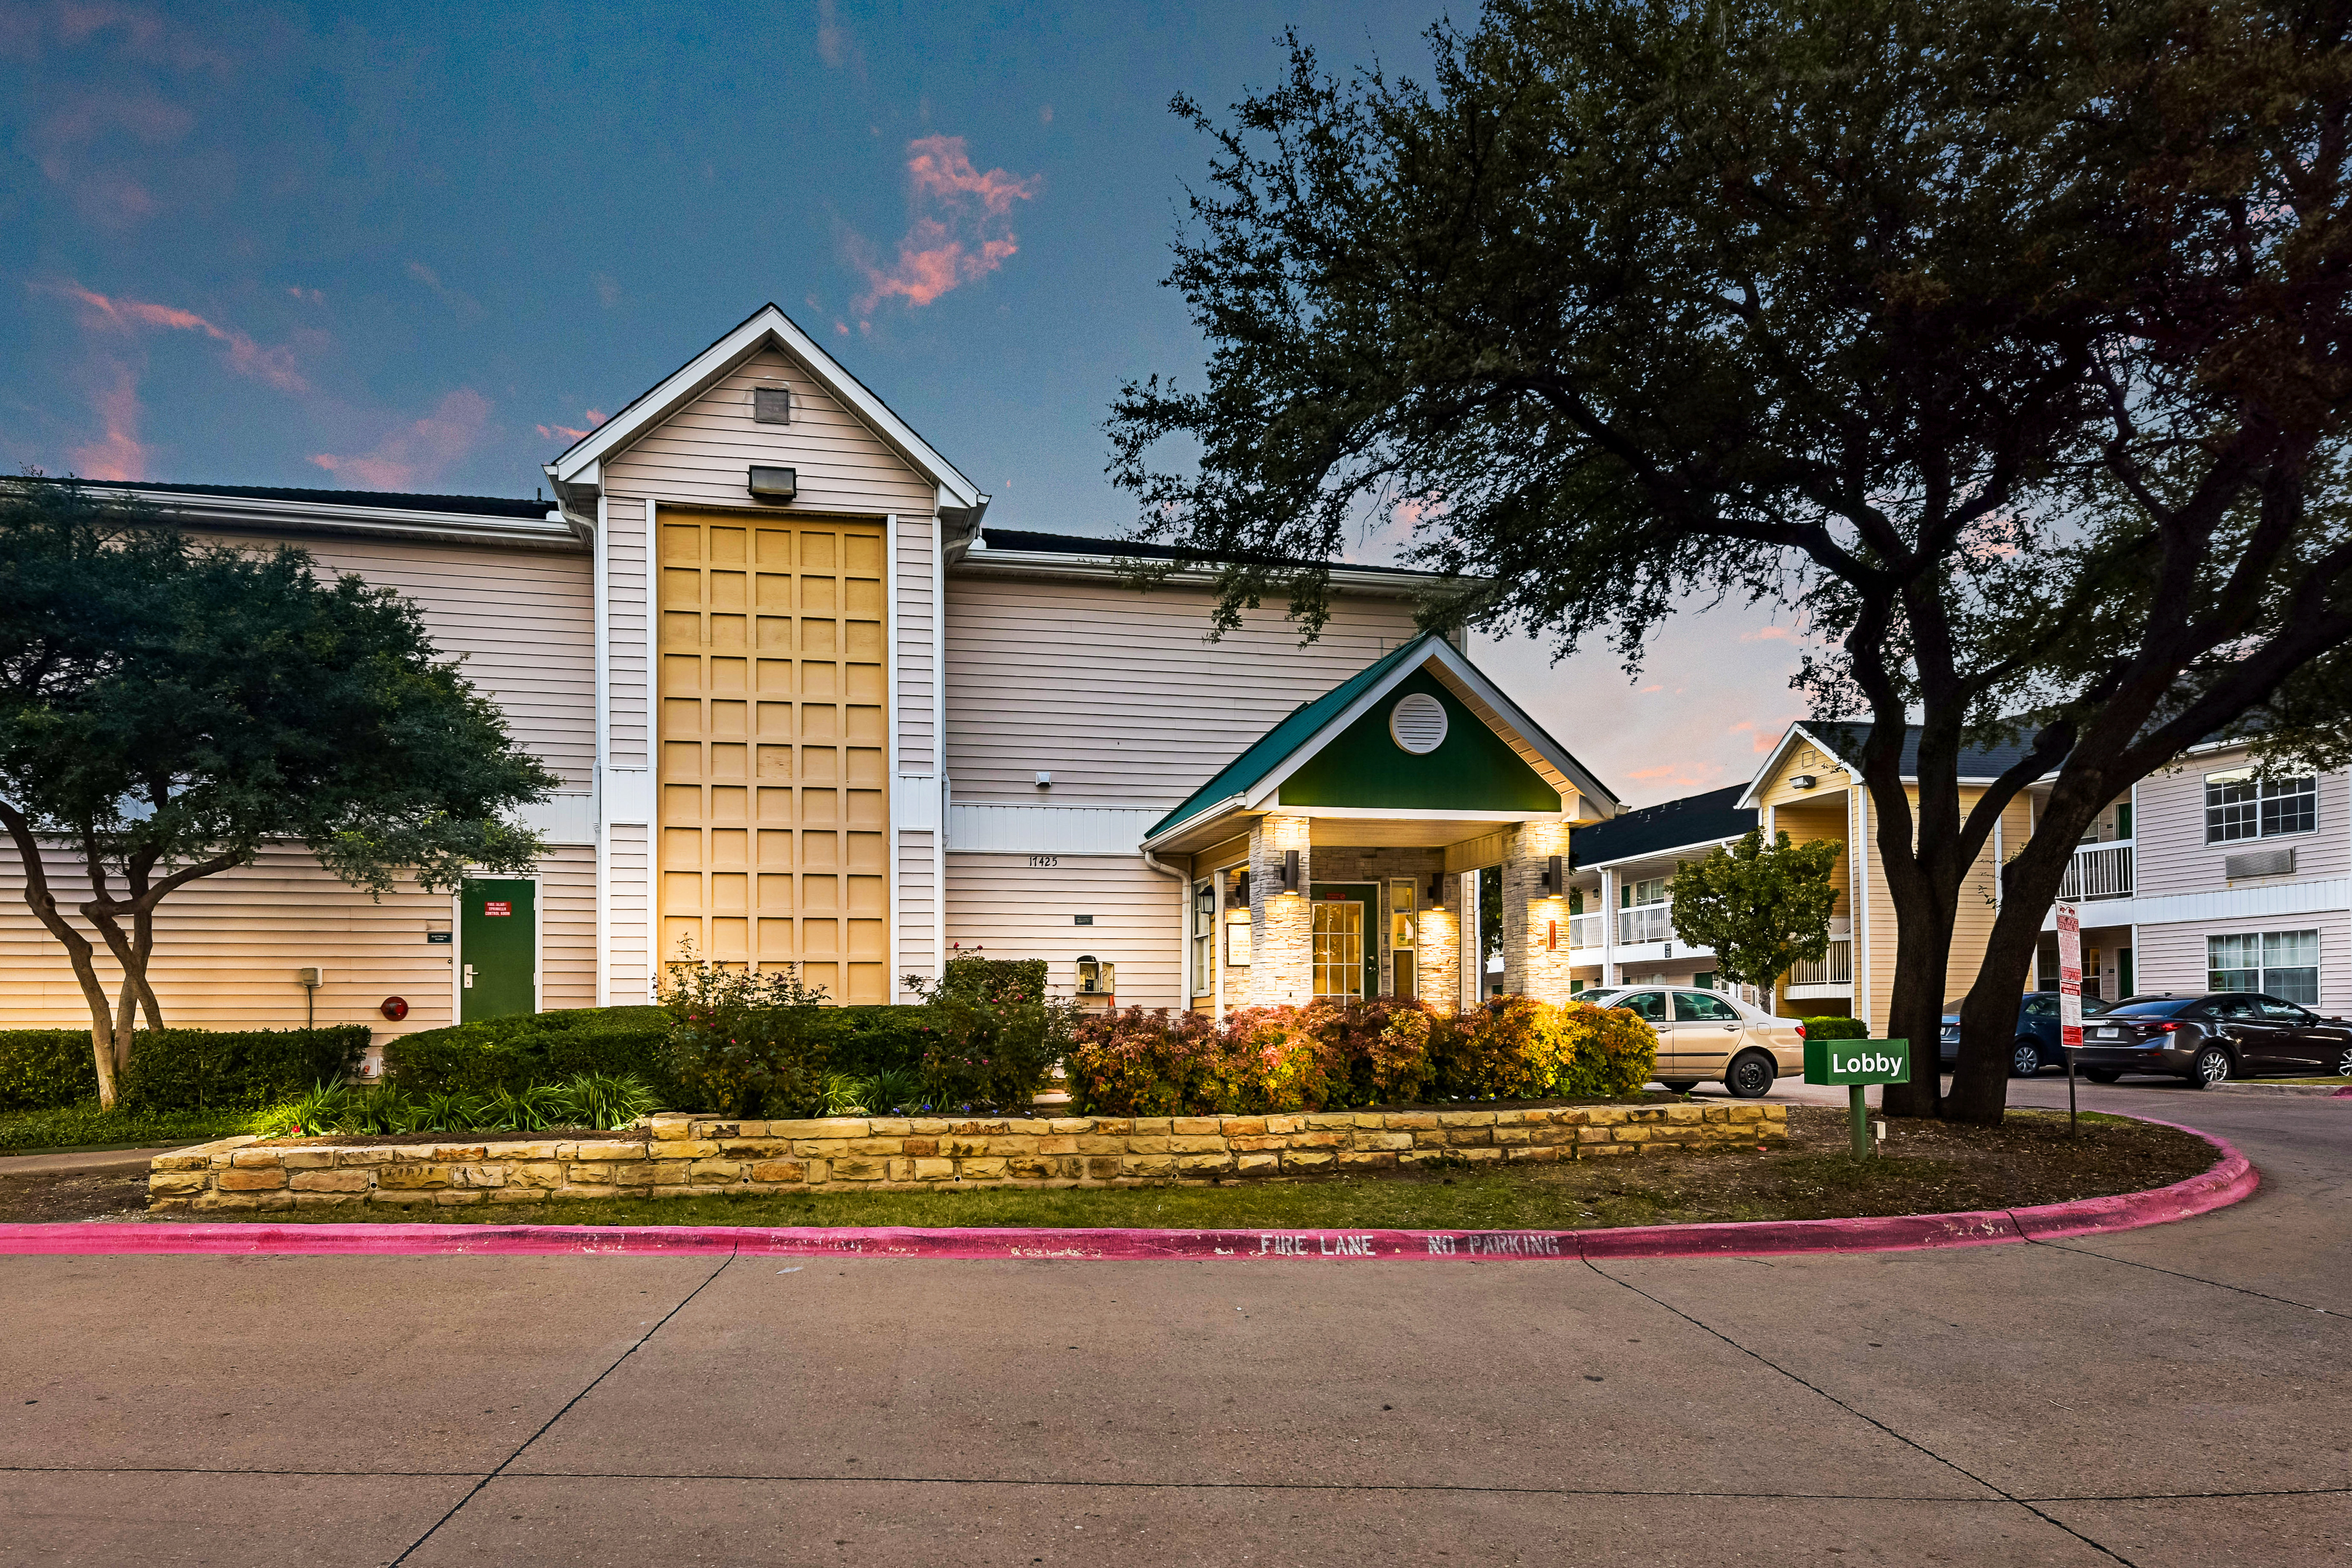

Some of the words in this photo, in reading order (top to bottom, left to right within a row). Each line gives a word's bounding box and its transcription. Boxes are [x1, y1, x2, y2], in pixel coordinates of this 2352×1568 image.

[1029, 857, 1057, 867] 17425
[1833, 1052, 1902, 1077] Lobby
[1261, 1235, 1308, 1256] FIRE
[1320, 1235, 1376, 1255] LANE
[1427, 1235, 1456, 1255] NO
[1469, 1235, 1560, 1256] PARKING
